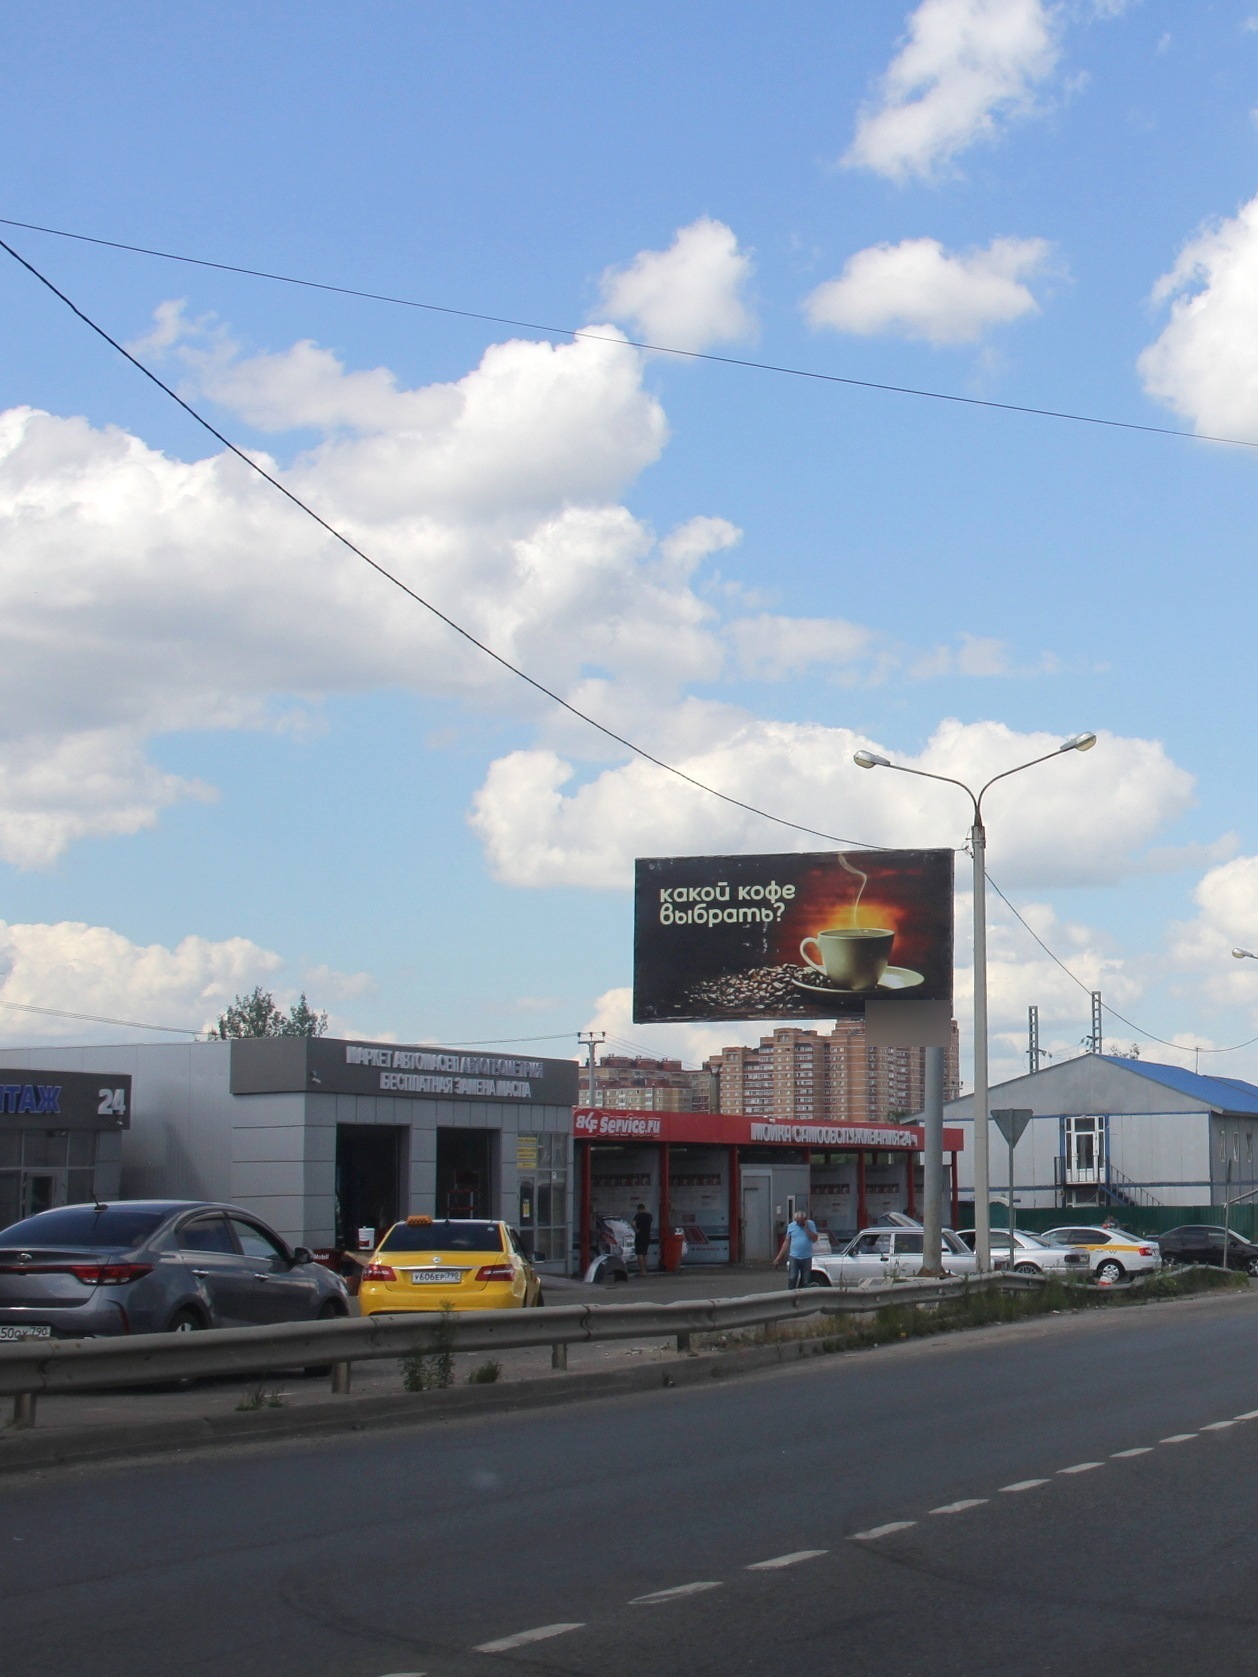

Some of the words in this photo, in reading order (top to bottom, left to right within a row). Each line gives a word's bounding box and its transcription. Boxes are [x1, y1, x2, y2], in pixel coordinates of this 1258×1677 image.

[660, 882, 730, 903] какой
[738, 880, 796, 904] кофе
[659, 902, 786, 928] выбрать?
[346, 1046, 393, 1068] МАРКЕТ
[393, 1050, 459, 1072] АВТОМАСЕЛ
[380, 1072, 453, 1094] БЕСПЛАТНАЯ
[453, 1077, 495, 1096] ЗАМЕНА
[495, 1080, 532, 1098] МАСЛА
[97, 1088, 126, 1115] 24
[751, 1122, 792, 1142] МОЙКА
[792, 1125, 900, 1146] САМООБСЛУЖИВАНИЯ
